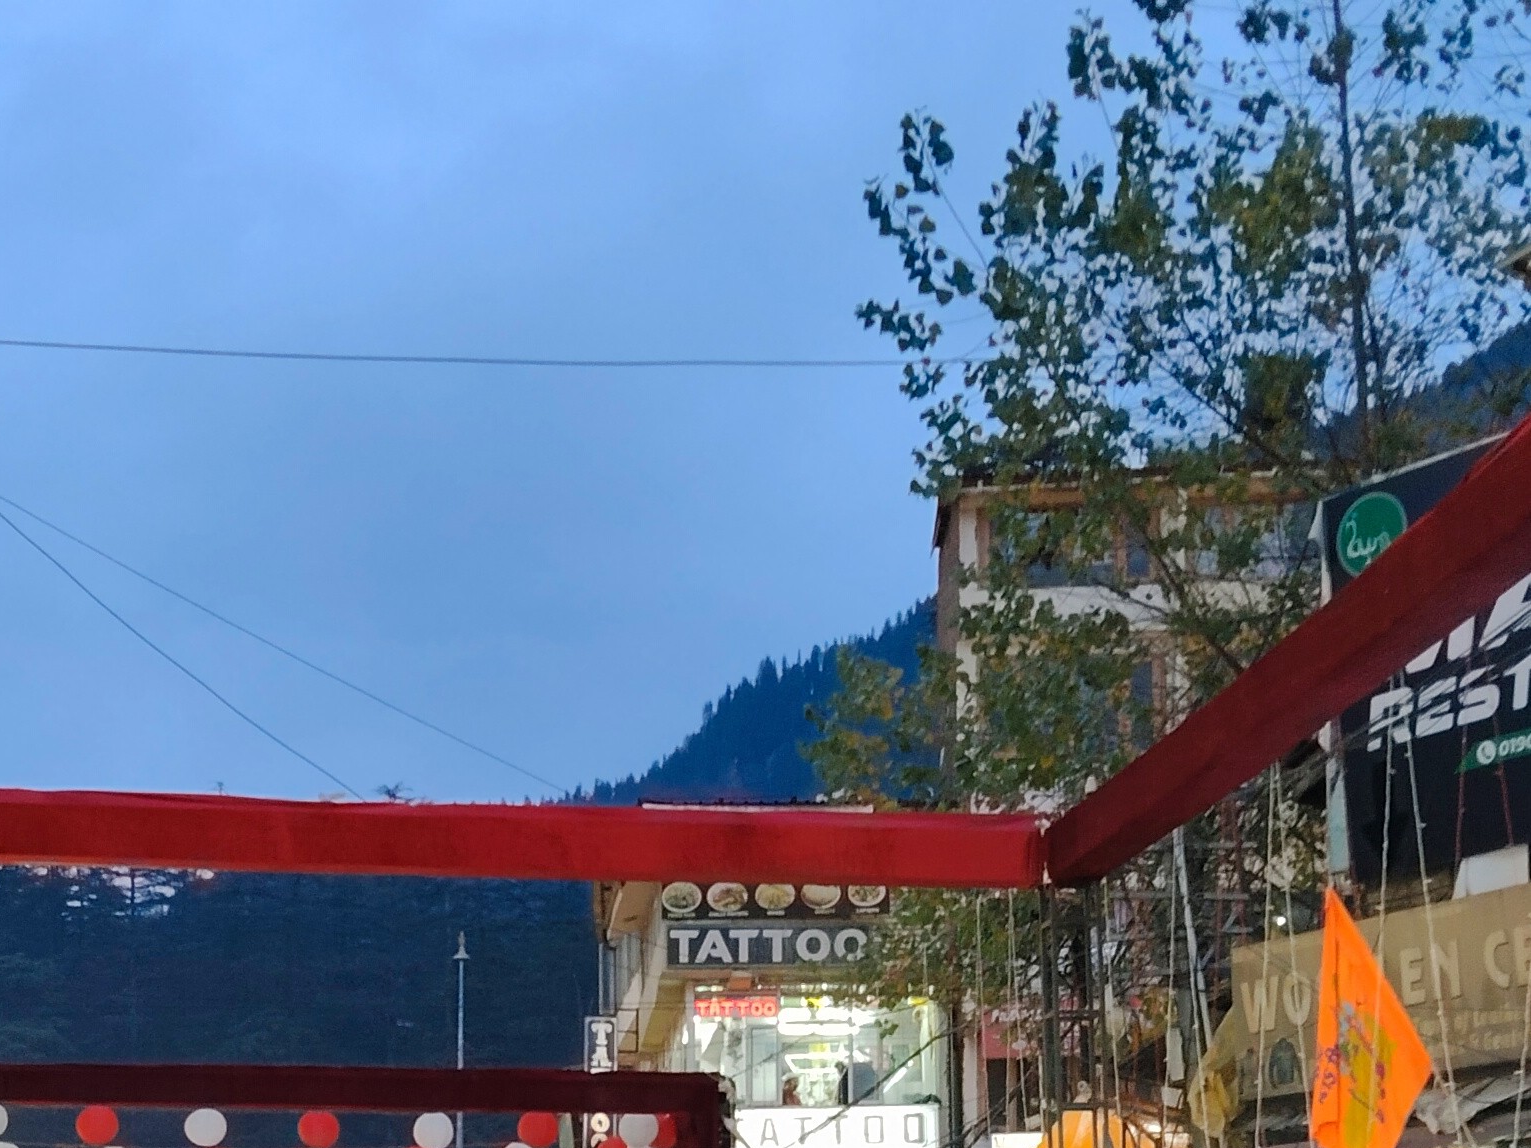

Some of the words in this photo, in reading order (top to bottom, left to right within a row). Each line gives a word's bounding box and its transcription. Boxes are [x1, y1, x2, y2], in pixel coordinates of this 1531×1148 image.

[669, 928, 868, 964] TATTOO
[1240, 936, 1462, 1035] WOEN
[696, 998, 778, 1018] TATTOO
